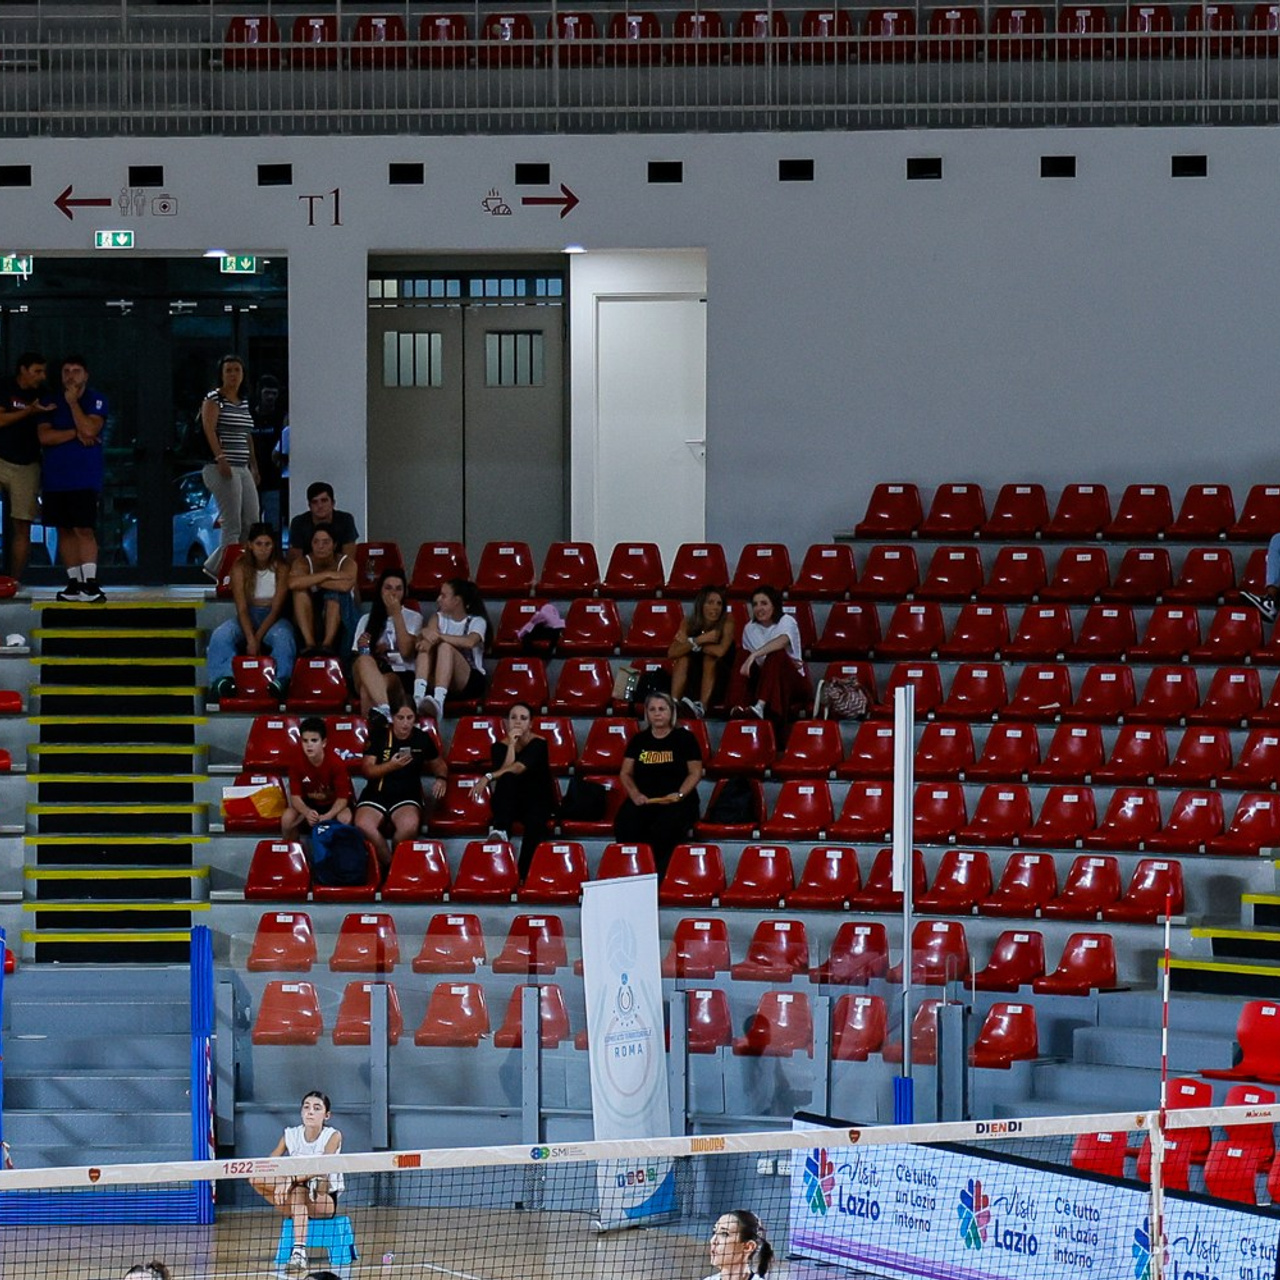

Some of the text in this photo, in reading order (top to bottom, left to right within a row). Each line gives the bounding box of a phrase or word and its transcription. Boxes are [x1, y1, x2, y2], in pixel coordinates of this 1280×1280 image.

[298, 187, 345, 227] T1
[614, 1043, 643, 1058] ROMA
[975, 1121, 1023, 1134] DIENDI
[222, 1161, 254, 1174] 1522
[837, 1152, 881, 1188] Visit
[838, 1185, 881, 1221] Lazio
[910, 1190, 936, 1211] Lazio
[993, 1185, 1038, 1222] Visit
[1072, 1200, 1100, 1222] tutto
[894, 1211, 931, 1233] intorno
[994, 1219, 1038, 1256] Lazio
[1070, 1223, 1098, 1246] Lazio
[1172, 1224, 1220, 1263] Visit
[1054, 1244, 1093, 1269] intorno
[1259, 1242, 1277, 1261] tut
